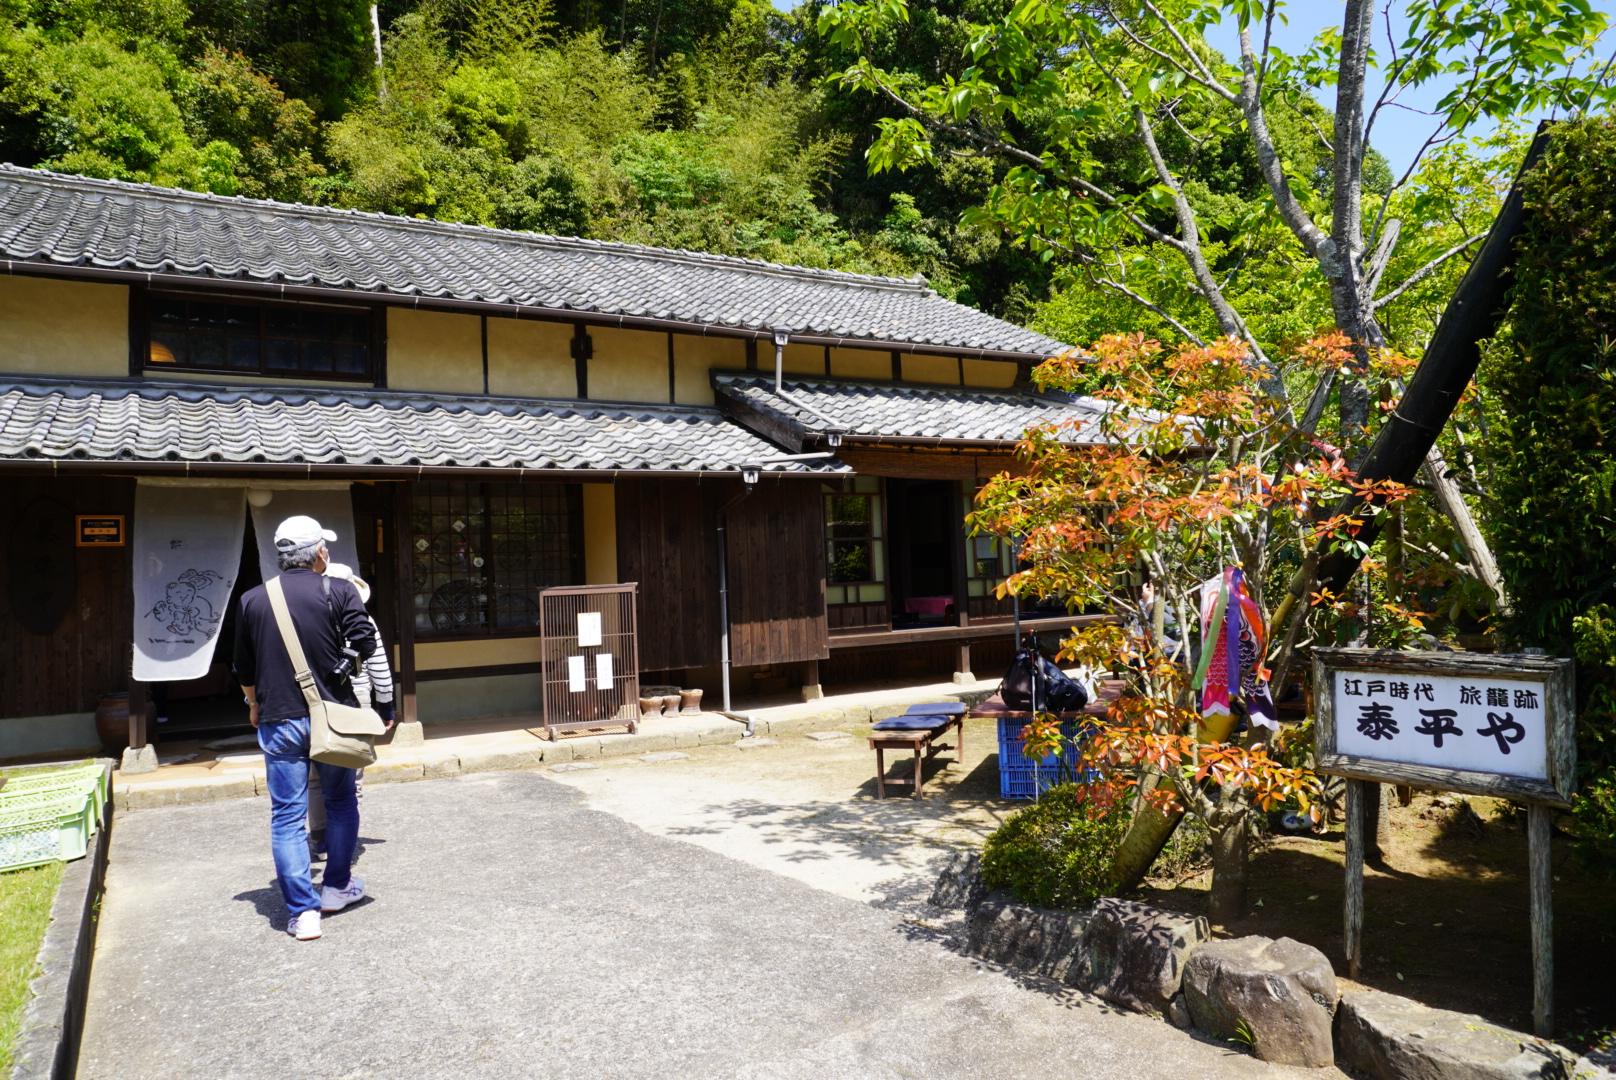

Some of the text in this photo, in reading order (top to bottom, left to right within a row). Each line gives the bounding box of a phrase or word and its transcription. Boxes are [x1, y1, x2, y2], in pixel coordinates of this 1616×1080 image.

[1344, 678, 1539, 710] 江戸時代 旅籠跡
[1356, 701, 1526, 755] 泰平や
